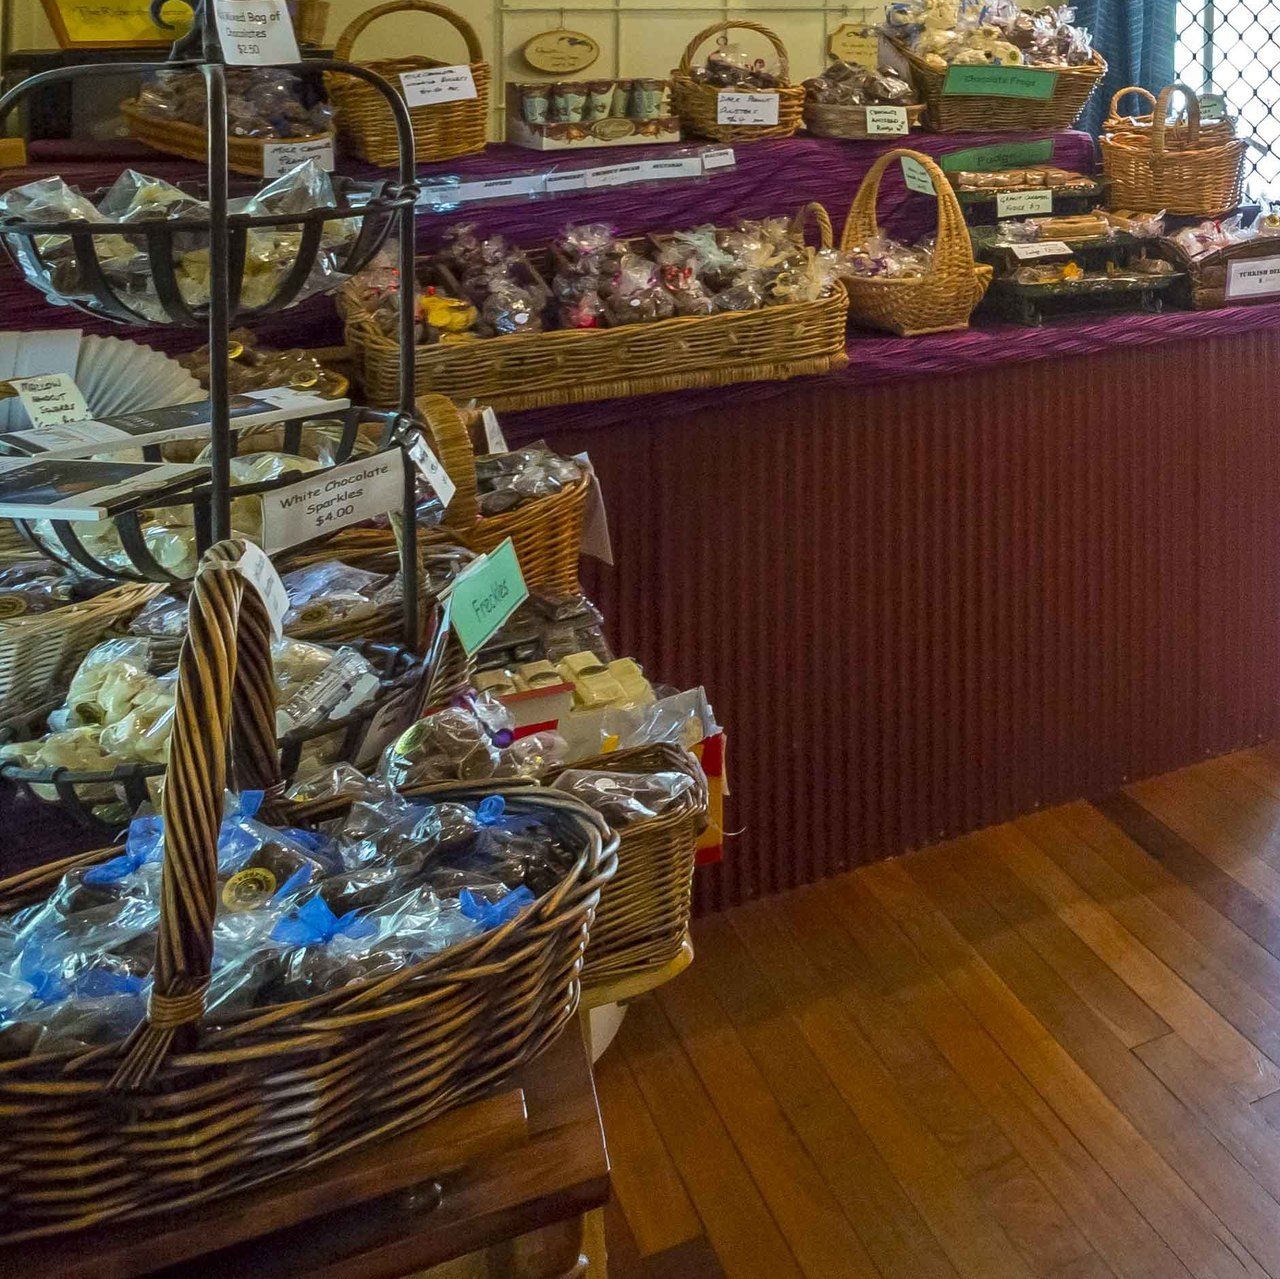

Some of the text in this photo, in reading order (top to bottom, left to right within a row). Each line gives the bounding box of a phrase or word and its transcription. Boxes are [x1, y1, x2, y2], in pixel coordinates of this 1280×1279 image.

[247, 12, 268, 25] Bag
[270, 11, 281, 22] of
[1239, 269, 1268, 279] TURKISH
[279, 464, 388, 510] White Chocolate
[306, 488, 364, 516] Sparkles
[316, 504, 355, 527] $4.00
[472, 578, 511, 622] Freckles
